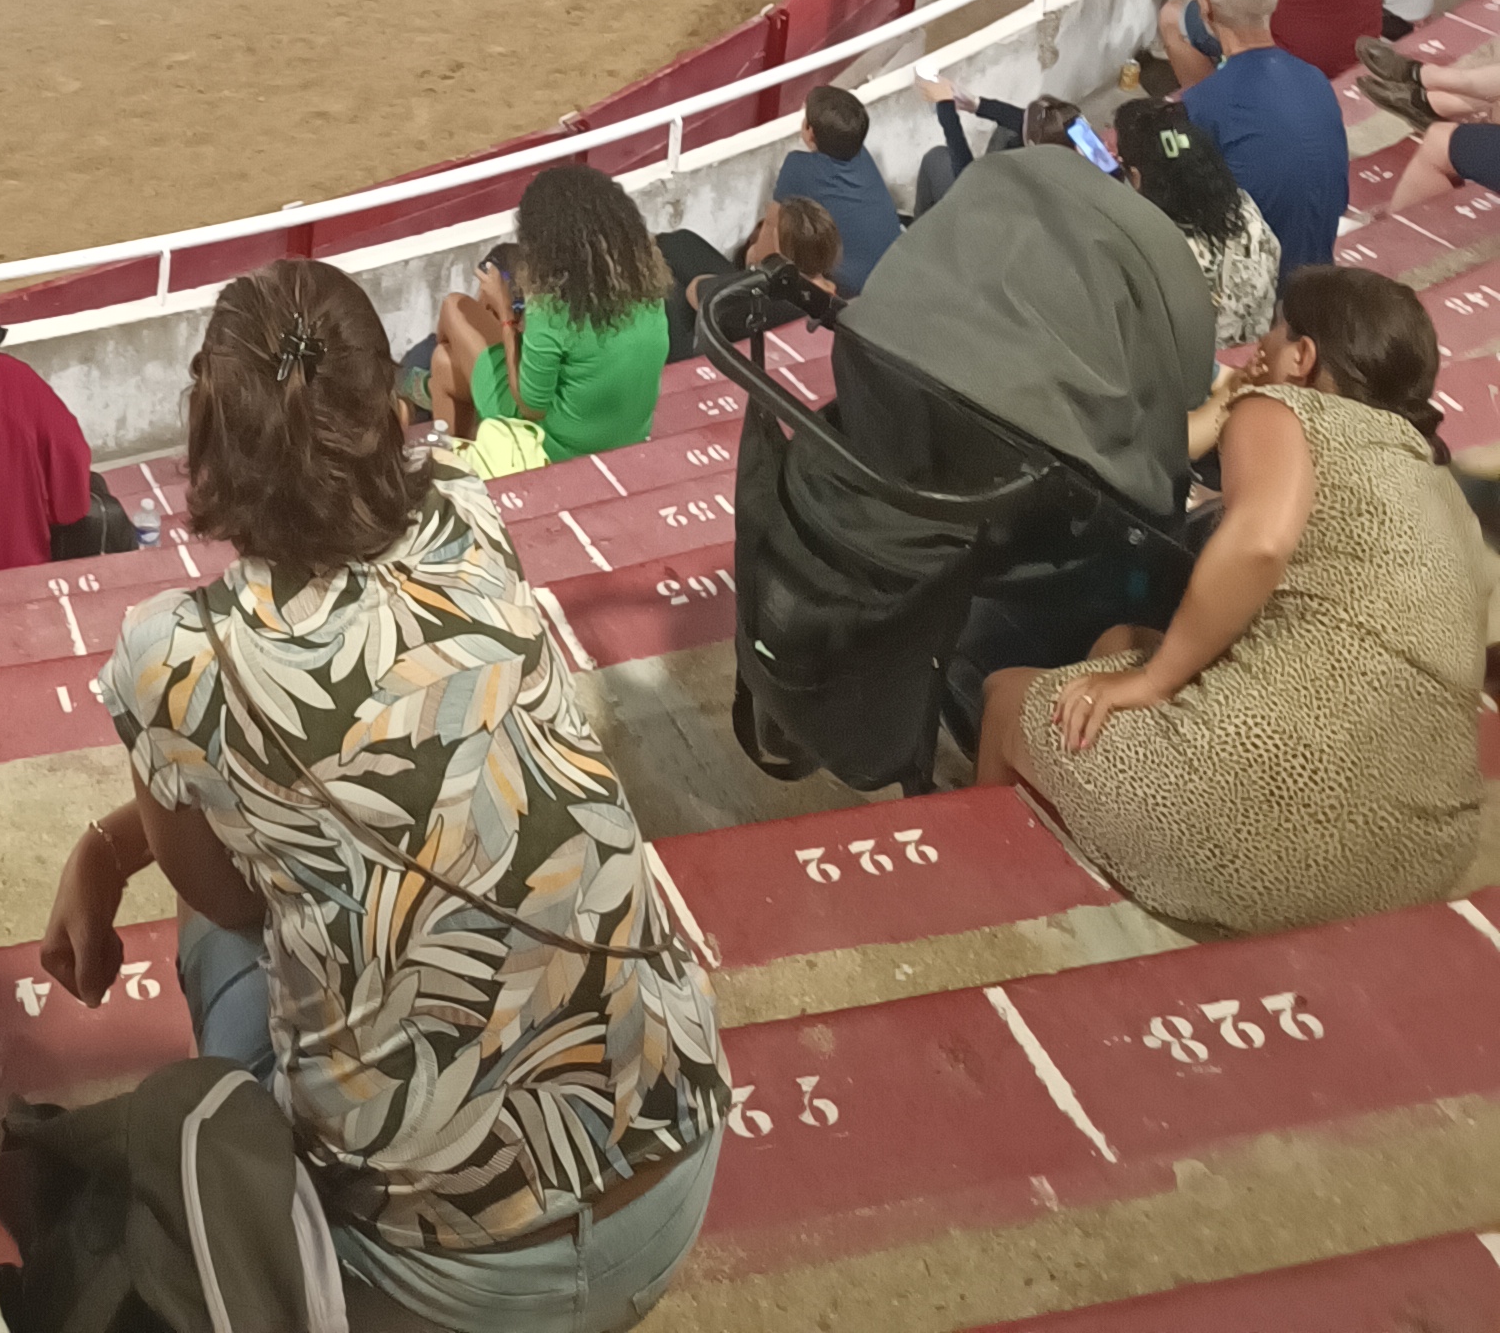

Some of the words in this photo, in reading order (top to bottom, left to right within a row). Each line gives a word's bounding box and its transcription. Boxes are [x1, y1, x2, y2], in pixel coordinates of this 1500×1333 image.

[795, 829, 939, 884] 222
[15, 961, 161, 1017] 24
[1148, 991, 1324, 1064] 228
